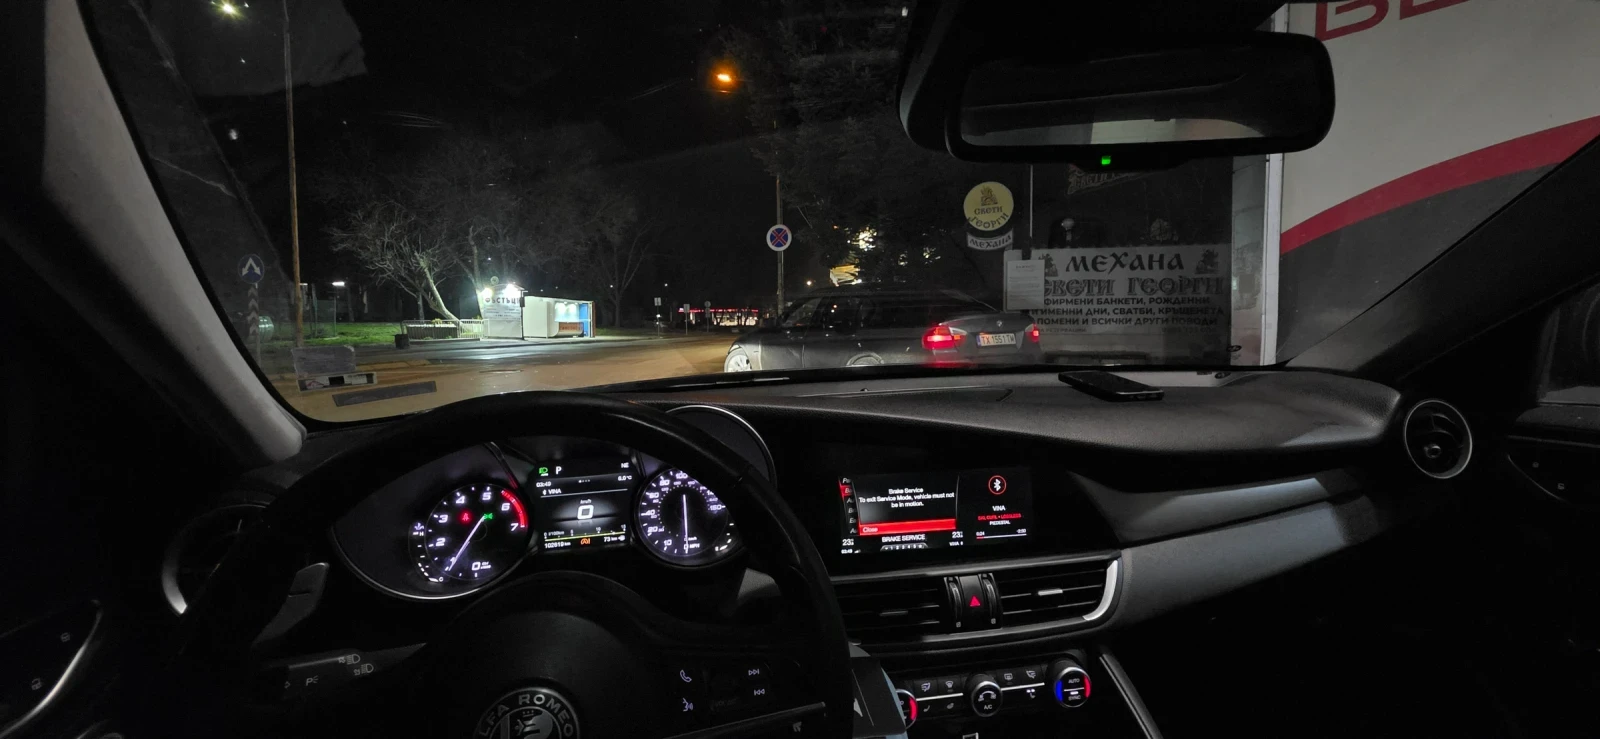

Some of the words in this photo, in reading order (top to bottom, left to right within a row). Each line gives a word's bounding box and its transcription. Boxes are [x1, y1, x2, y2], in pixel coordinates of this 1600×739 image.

[974, 206, 1003, 216] СВЕТИ
[968, 212, 1009, 229] ГЕОРГИ
[969, 235, 1012, 249] МЕХАНА
[1065, 252, 1185, 275] МЕХАНА
[1127, 275, 1225, 297] ГЕОРГИ
[1044, 298, 1094, 306] ФИРМЕНИ
[1096, 297, 1147, 306] БАНКЕТИ,
[1149, 296, 1211, 305] РОЖДЕННИ
[1040, 307, 1083, 316] ИМЕННИ
[1085, 307, 1110, 317] ДНИ,
[1112, 307, 1156, 316] СВАТБИ,
[1158, 306, 1226, 317] КРЪЩЕНЕТА
[1036, 317, 1080, 326] ПОМЕНИ
[1081, 317, 1089, 325] И
[1091, 317, 1132, 326] ВСИЧКИ
[1134, 317, 1168, 327] ДРУГИ
[1171, 316, 1218, 326] ПОВОДИ
[981, 335, 991, 345] TX
[991, 334, 1005, 344] 1551
[555, 466, 562, 475] P
[455, 496, 465, 504] 4
[482, 491, 492, 501] 5
[501, 503, 511, 512] 6
[577, 504, 594, 520] 0
[438, 514, 449, 524] 3
[510, 523, 519, 532] 7
[435, 537, 446, 547] 2
[881, 535, 902, 543] BRAKE
[901, 534, 926, 542] SERVICE
[471, 562, 481, 571] 0
[478, 704, 510, 737] LFA
[518, 693, 574, 737] ROMEO
